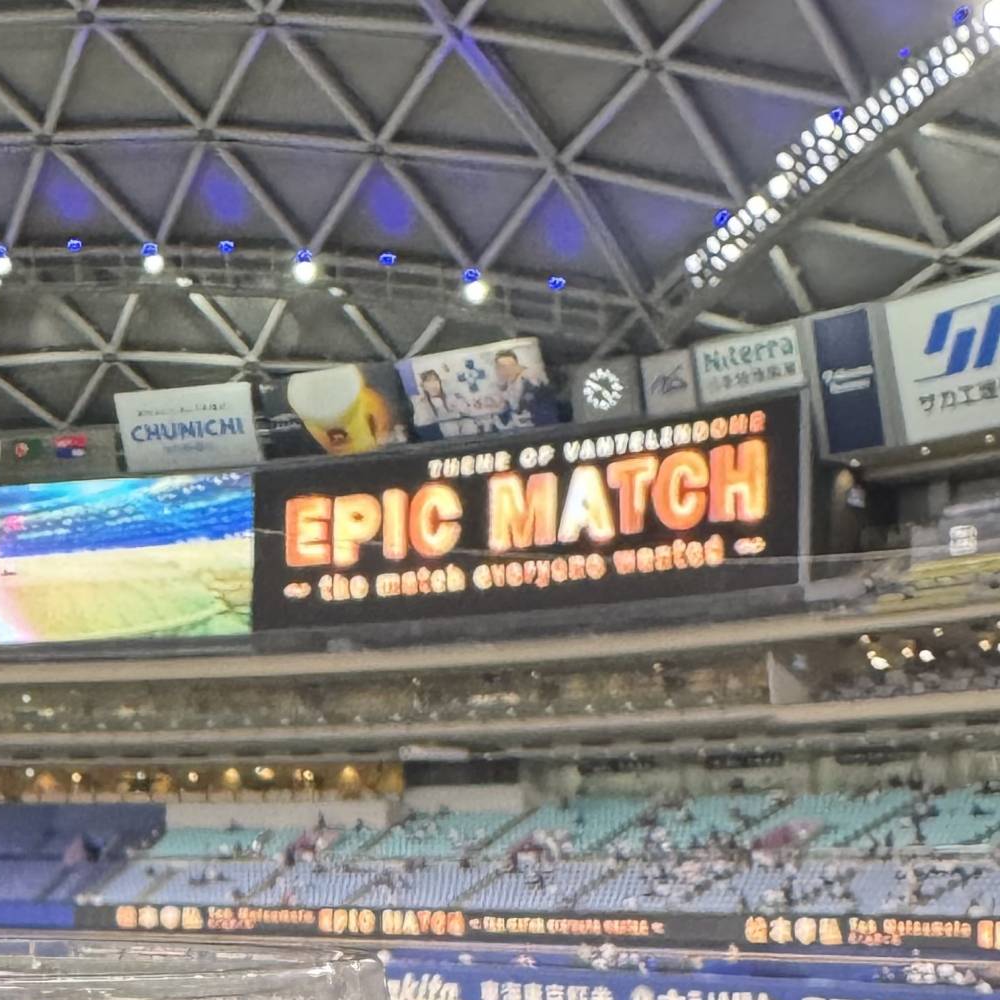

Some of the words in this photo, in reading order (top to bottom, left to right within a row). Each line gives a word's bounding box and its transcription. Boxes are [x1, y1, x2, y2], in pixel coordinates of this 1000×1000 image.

[130, 417, 245, 441] CHUNICHI
[284, 484, 463, 567] EPIC
[488, 439, 769, 552] MATCH
